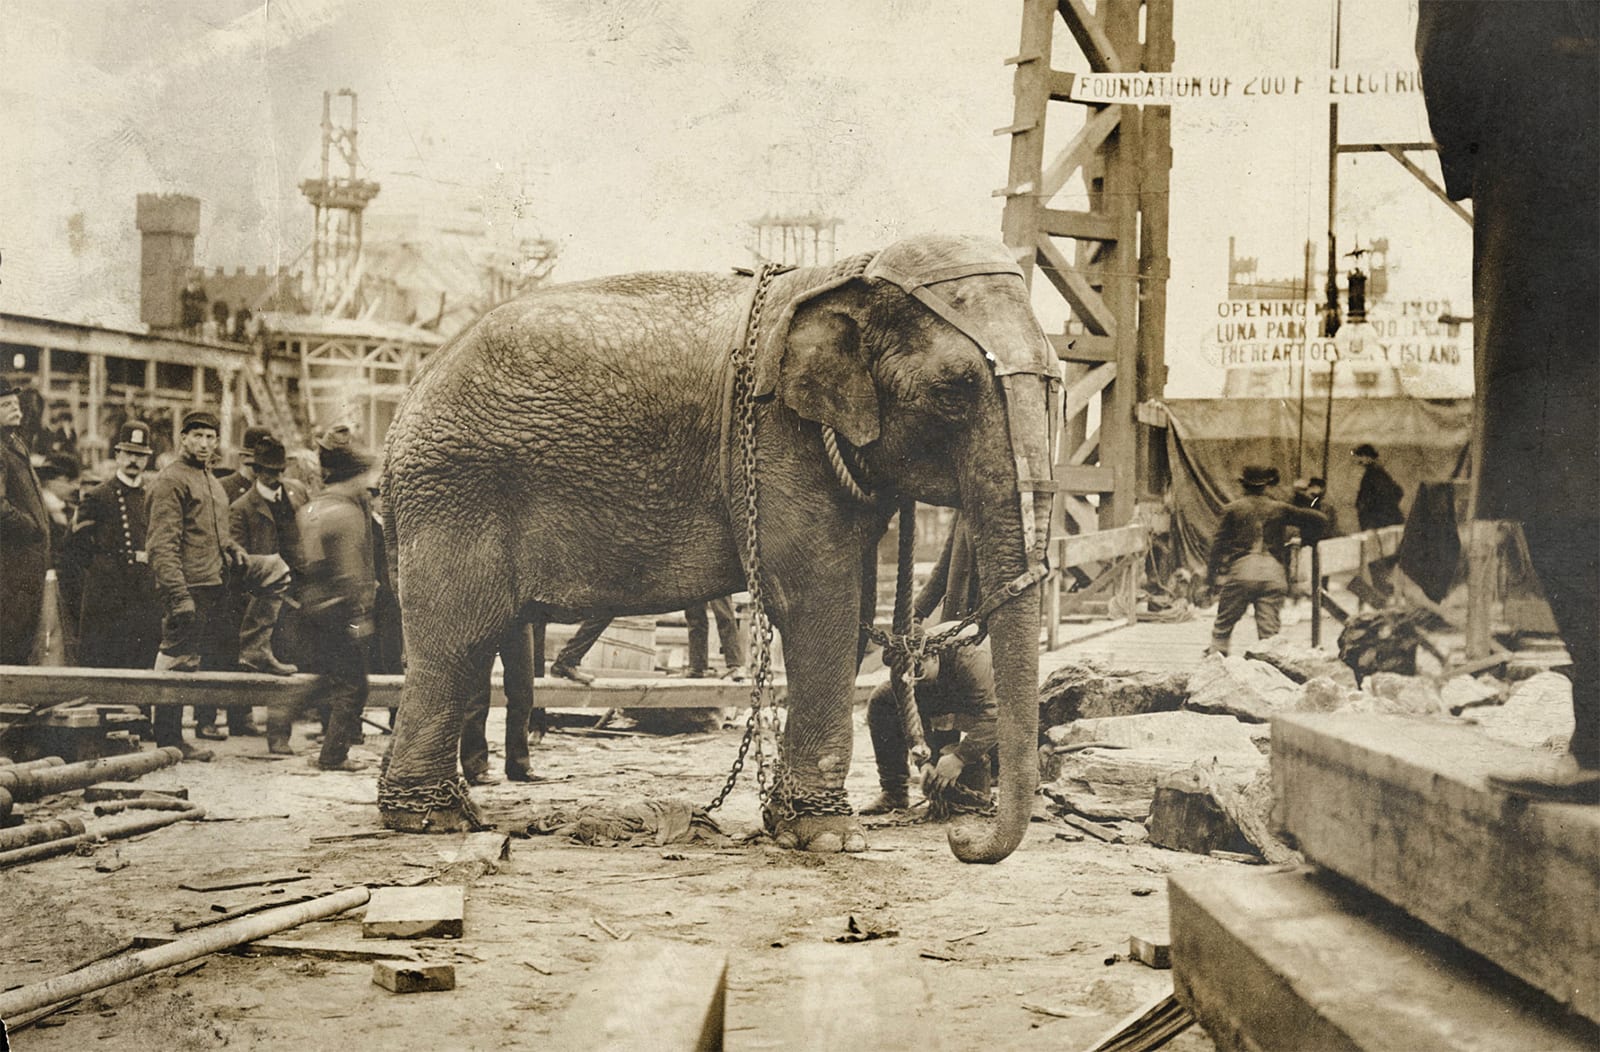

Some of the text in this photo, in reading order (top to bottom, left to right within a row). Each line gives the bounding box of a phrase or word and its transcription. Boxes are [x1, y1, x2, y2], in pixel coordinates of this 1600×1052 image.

[1079, 76, 1201, 98] FOUNDATION
[1217, 302, 1306, 318] OPENING
[1216, 321, 1257, 343] LUNA
[1266, 320, 1306, 339] PARK
[1399, 343, 1460, 365] ISLAND
